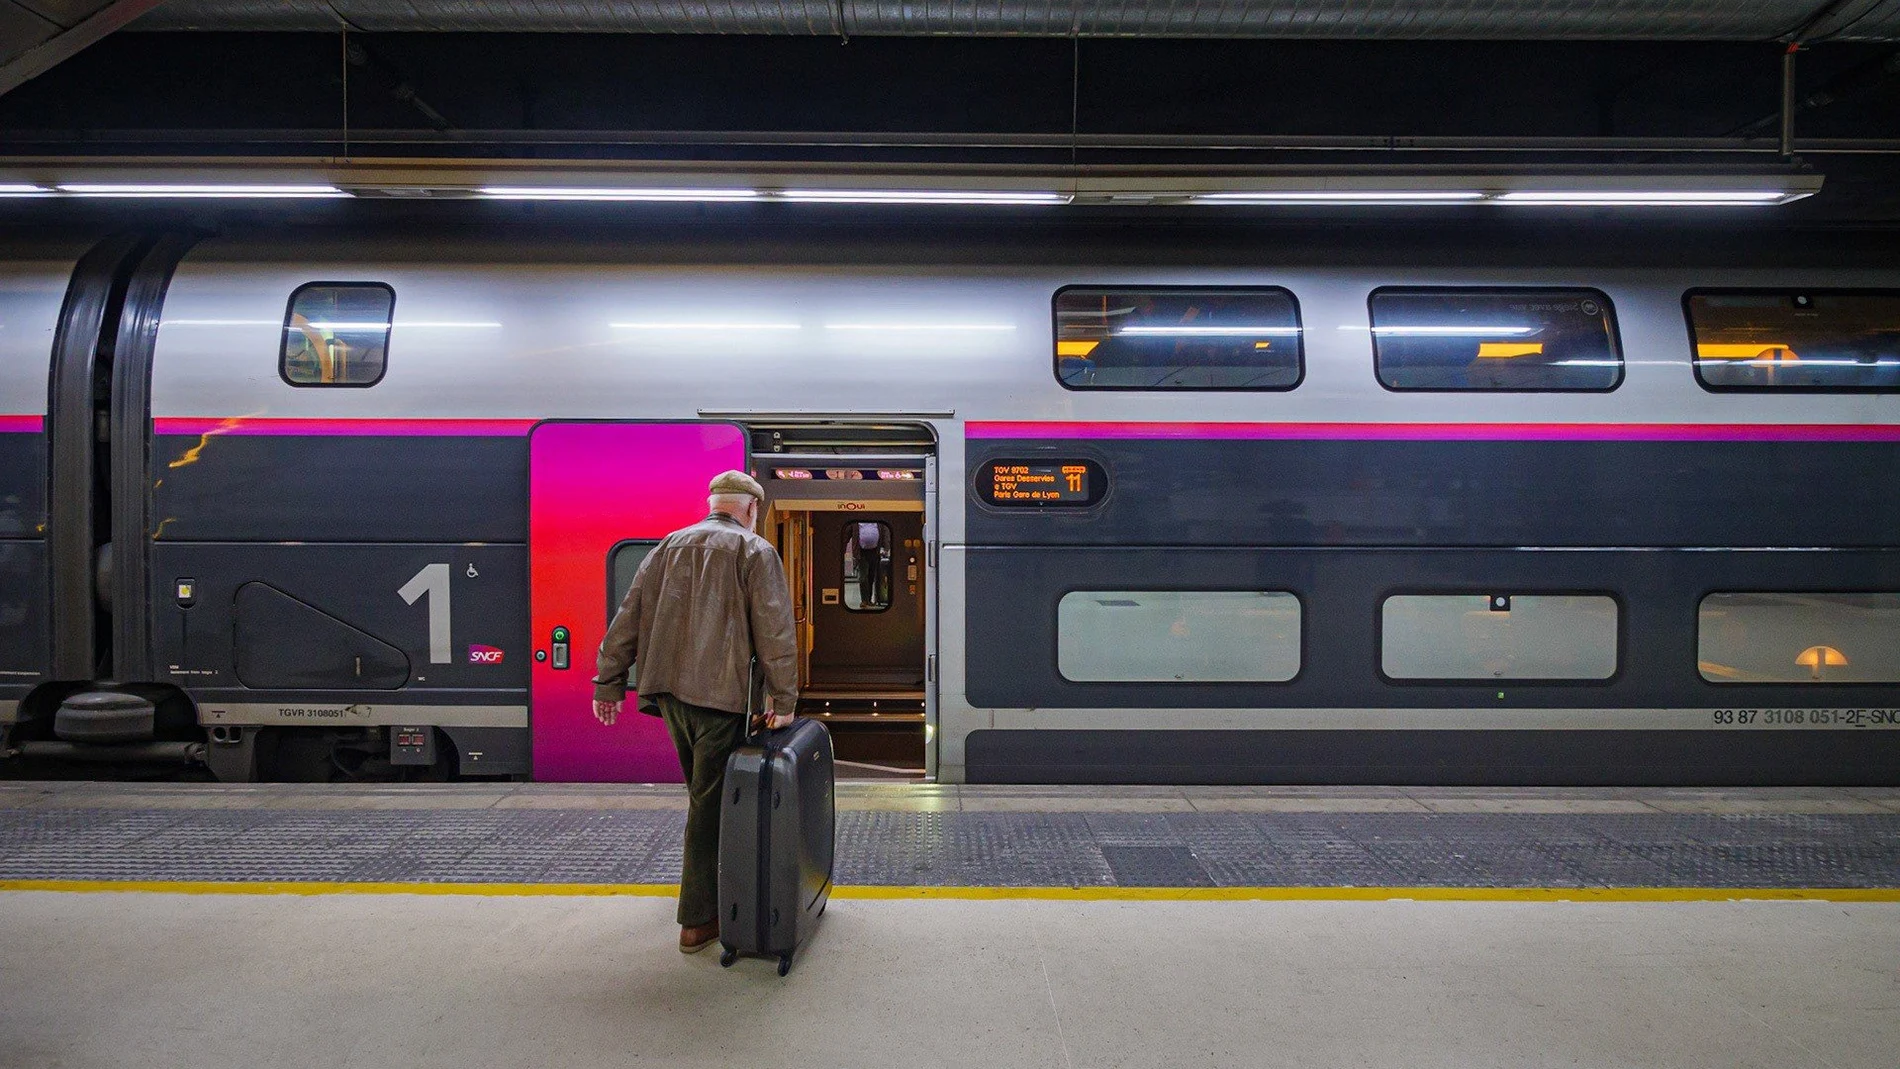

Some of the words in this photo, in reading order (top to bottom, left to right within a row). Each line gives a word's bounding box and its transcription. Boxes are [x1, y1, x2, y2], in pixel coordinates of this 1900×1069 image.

[994, 466, 1009, 474] TGV
[1001, 482, 1017, 490] TGV
[1066, 474, 1081, 492] 11
[1013, 491, 1030, 499] Gare
[1031, 491, 1041, 499] de
[1042, 491, 1060, 499] Lyon
[397, 564, 451, 663] 1
[470, 651, 502, 661] SNCF
[279, 708, 304, 717] TGVR
[307, 709, 344, 717] 3108051
[1714, 710, 1733, 724] 93
[1738, 710, 1757, 724] 87
[1764, 709, 1804, 724] 3108
